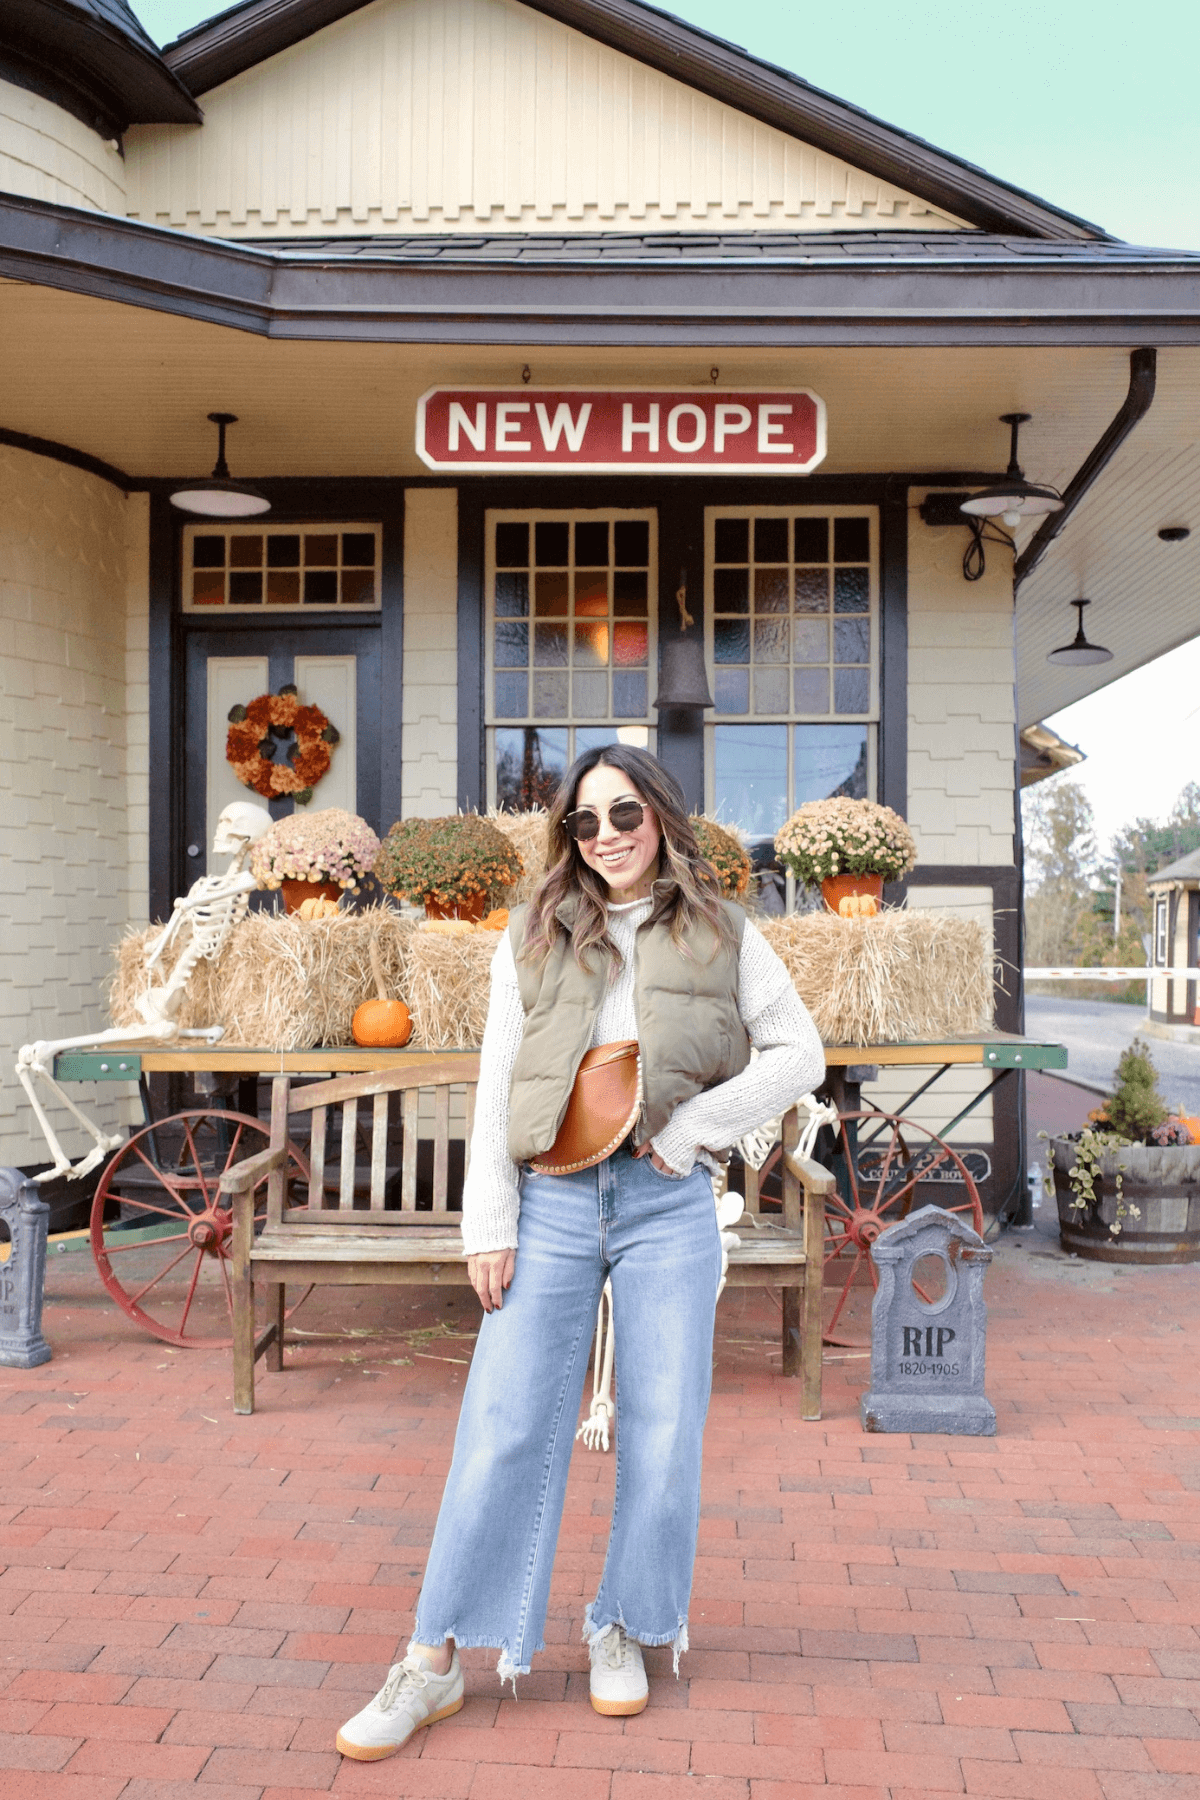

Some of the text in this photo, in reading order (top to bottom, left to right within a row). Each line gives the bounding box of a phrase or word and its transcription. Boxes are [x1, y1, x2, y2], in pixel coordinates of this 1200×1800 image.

[448, 402, 794, 454] NEW HOPE
[902, 1326, 956, 1357] RIP
[898, 1362, 960, 1376] 1820-1905
